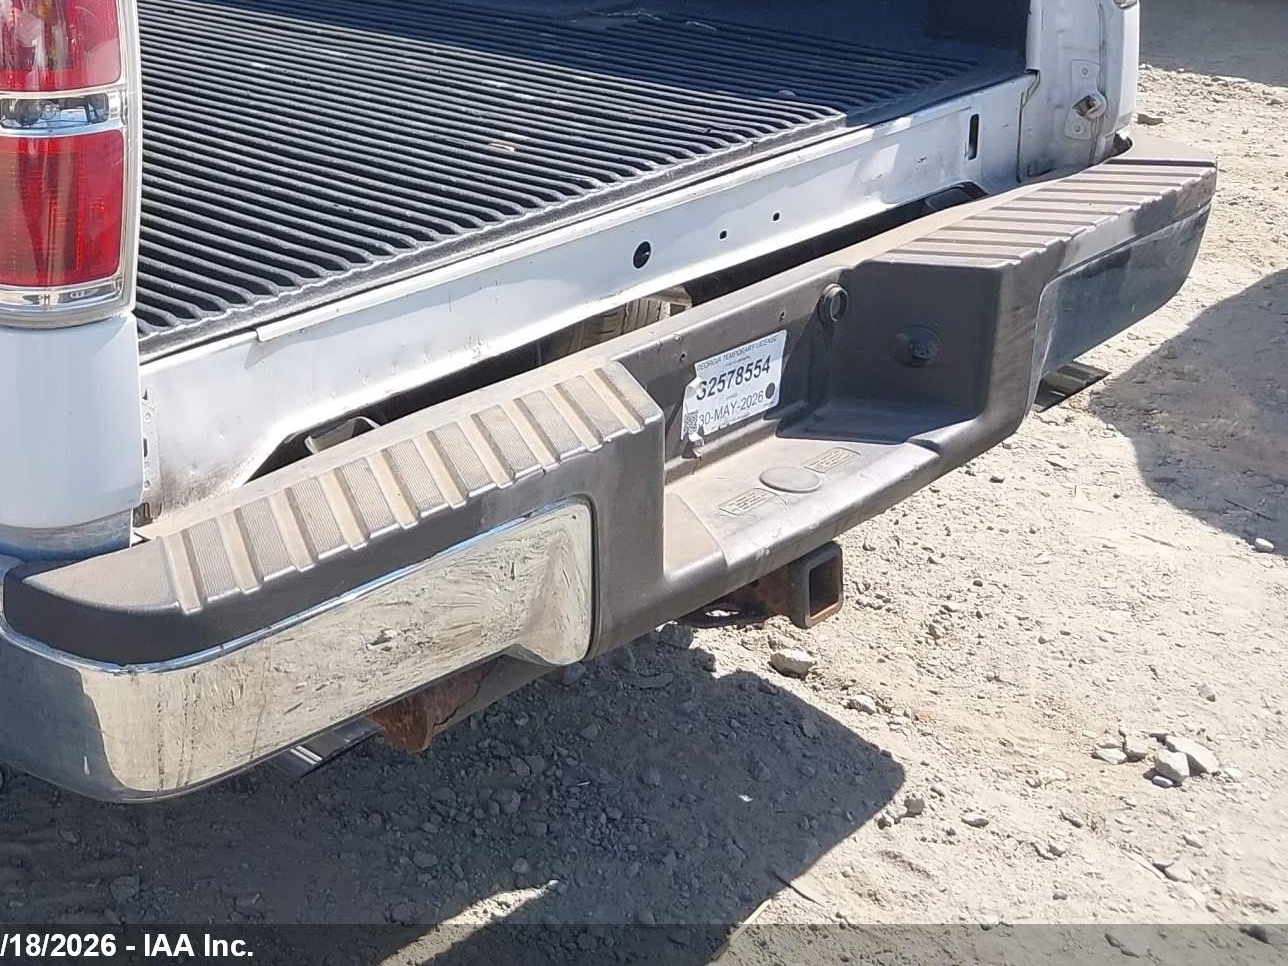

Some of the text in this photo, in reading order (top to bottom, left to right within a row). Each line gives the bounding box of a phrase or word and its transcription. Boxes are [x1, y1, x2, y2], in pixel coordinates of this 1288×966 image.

[722, 343, 756, 362] TEMPORARY
[696, 354, 771, 401] S2578554
[698, 390, 764, 427] 30-MAY-2026
